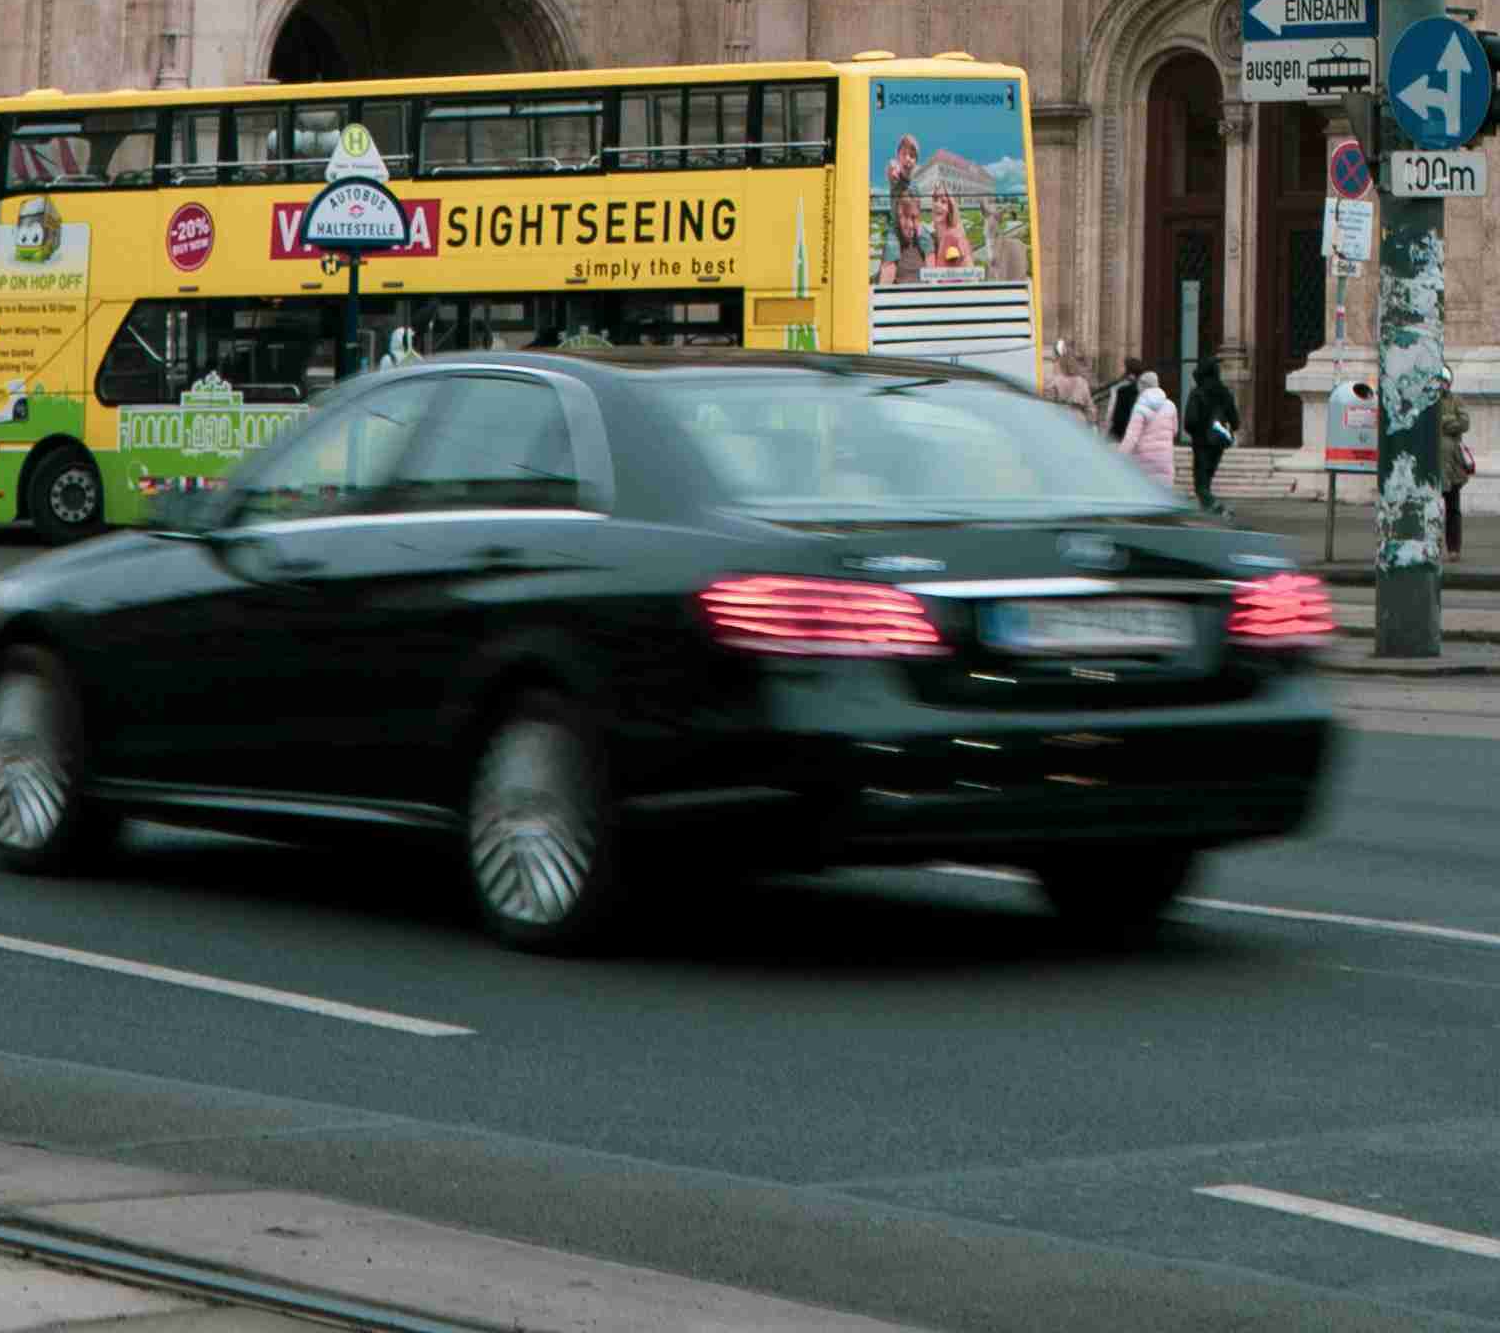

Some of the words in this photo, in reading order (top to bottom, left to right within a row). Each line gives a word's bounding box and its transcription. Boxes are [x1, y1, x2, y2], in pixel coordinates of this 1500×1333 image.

[1246, 59, 1306, 87] ausgen.
[349, 132, 363, 151] H
[329, 188, 388, 212] AUTOBUS
[172, 216, 210, 241] -20%
[316, 221, 397, 238] HALTESTELLE
[445, 198, 738, 248] SIGHTSEEING
[574, 259, 642, 281] simply
[650, 259, 682, 277] the
[691, 257, 736, 276] best
[11, 276, 28, 290] ON
[30, 275, 57, 289] HOP
[59, 274, 84, 288] OFF
